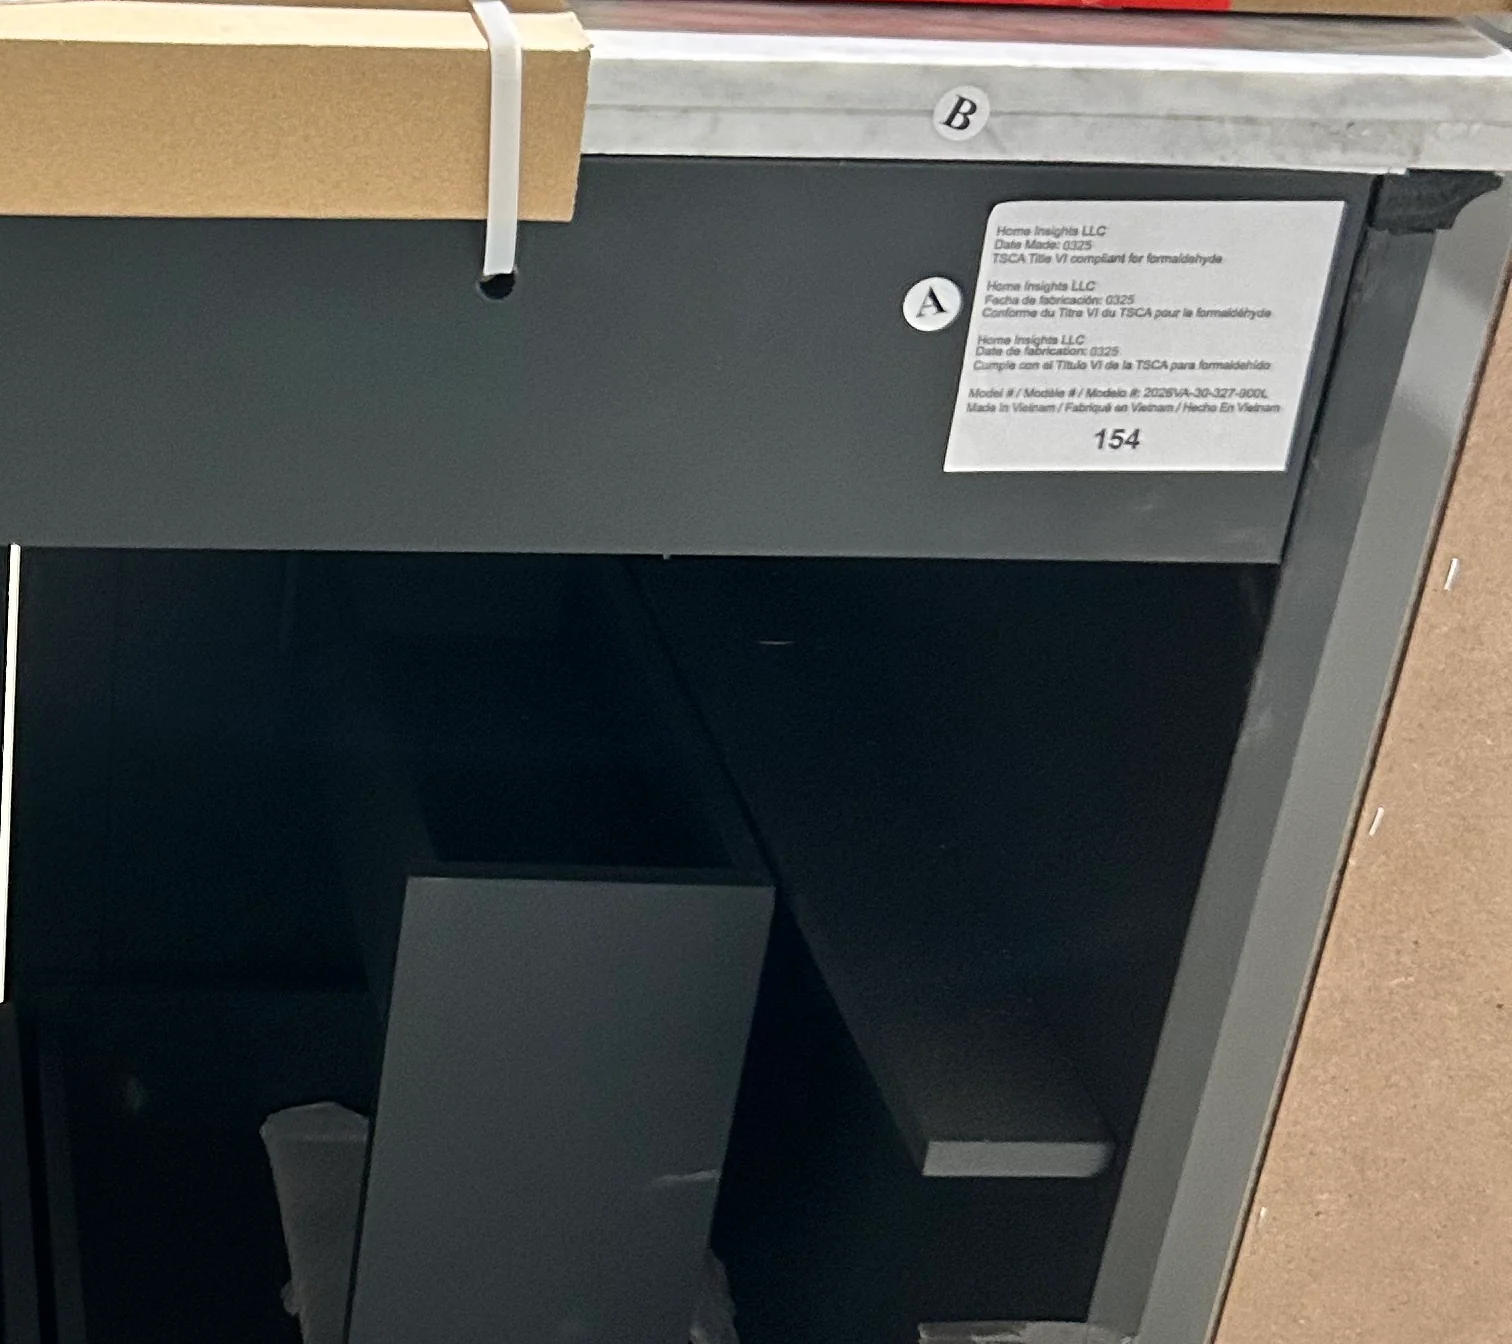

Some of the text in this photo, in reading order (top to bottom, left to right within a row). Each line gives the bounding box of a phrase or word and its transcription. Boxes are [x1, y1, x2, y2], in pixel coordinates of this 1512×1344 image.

[939, 94, 978, 131] B
[996, 225, 1107, 238] Home Insights LLC
[994, 239, 1022, 250] Date
[1024, 239, 1060, 250] Made:
[993, 252, 1026, 264] TSCA
[1055, 252, 1068, 264] VI
[1070, 252, 1125, 266] compliant
[1128, 252, 1144, 264] for
[1147, 252, 1223, 266] formaldehyde
[986, 280, 1097, 293] Home Insights LLC
[915, 285, 948, 319] A
[984, 294, 1019, 305] Fecha
[1021, 294, 1036, 305] de
[1105, 294, 1135, 305] 0325
[982, 307, 1037, 318] Conforme
[1040, 307, 1055, 318] du
[1059, 307, 1083, 318] Titre
[1086, 307, 1099, 318] VI
[1102, 307, 1116, 318] du
[1120, 307, 1152, 318] TSCA
[1154, 309, 1181, 320] pour
[1183, 307, 1193, 318] le
[977, 335, 1086, 347] Home Insights LLC
[976, 346, 1003, 356] Date
[1005, 346, 1020, 356] de
[973, 360, 1016, 372] Cumple
[1019, 361, 1040, 370] con
[1042, 359, 1053, 370] el
[1090, 359, 1103, 370] VI
[1105, 359, 1119, 370] de
[1122, 359, 1132, 370] la
[1136, 359, 1169, 370] TSCA
[1170, 361, 1195, 372] para
[968, 387, 1003, 398] Model
[1085, 387, 1127, 398] Modelo
[965, 402, 996, 413] Made
[1012, 402, 1056, 413] Vietnam
[1114, 403, 1128, 413] en
[1132, 402, 1174, 413] Vietnam
[1183, 402, 1217, 413] Hecho
[1219, 402, 1234, 413] En
[1238, 402, 1281, 413] Vietnam
[1093, 428, 1141, 450] 154
